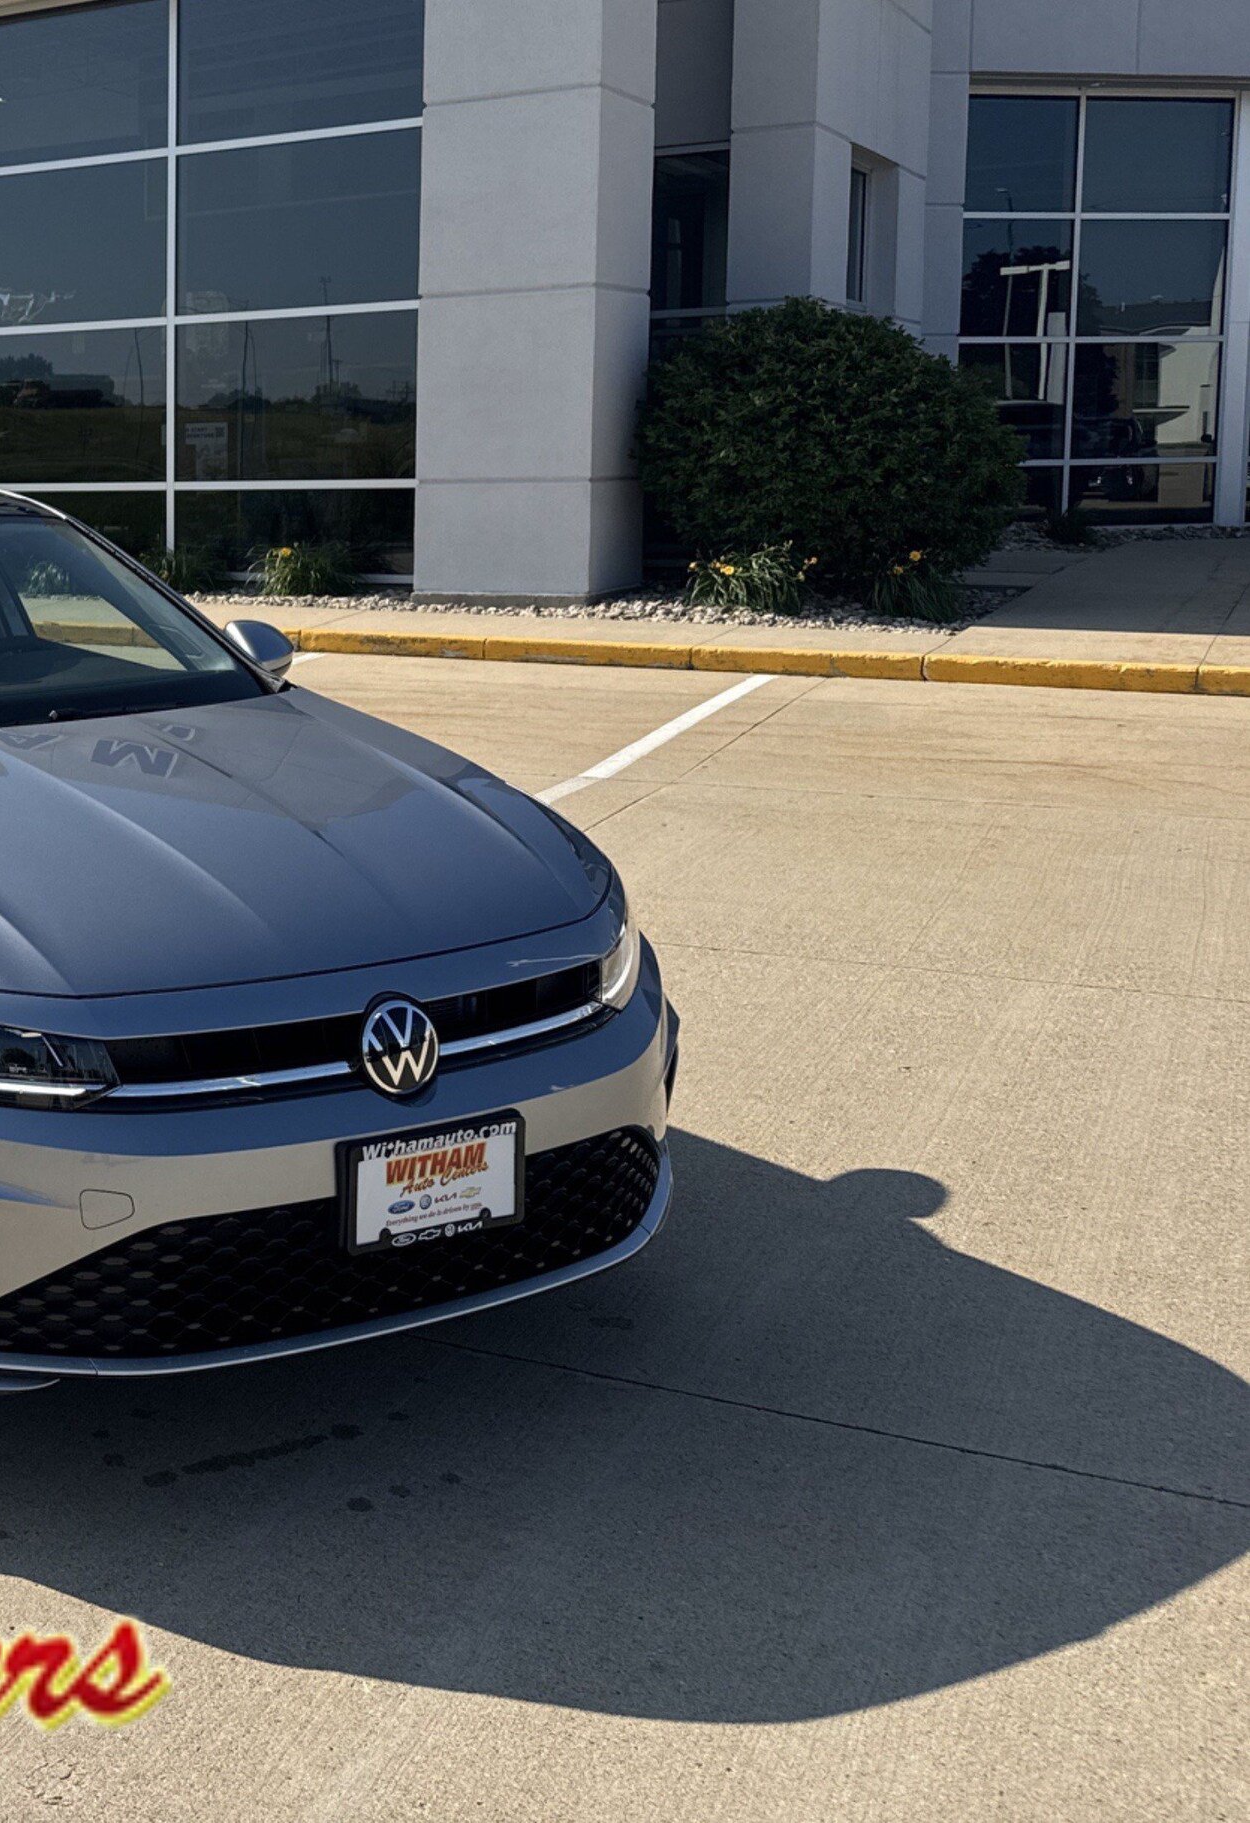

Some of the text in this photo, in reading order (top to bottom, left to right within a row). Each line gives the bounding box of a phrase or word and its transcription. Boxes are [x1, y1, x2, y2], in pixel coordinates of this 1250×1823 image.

[386, 1142, 487, 1186] WITHAM
[400, 1160, 489, 1198] Auto Centers
